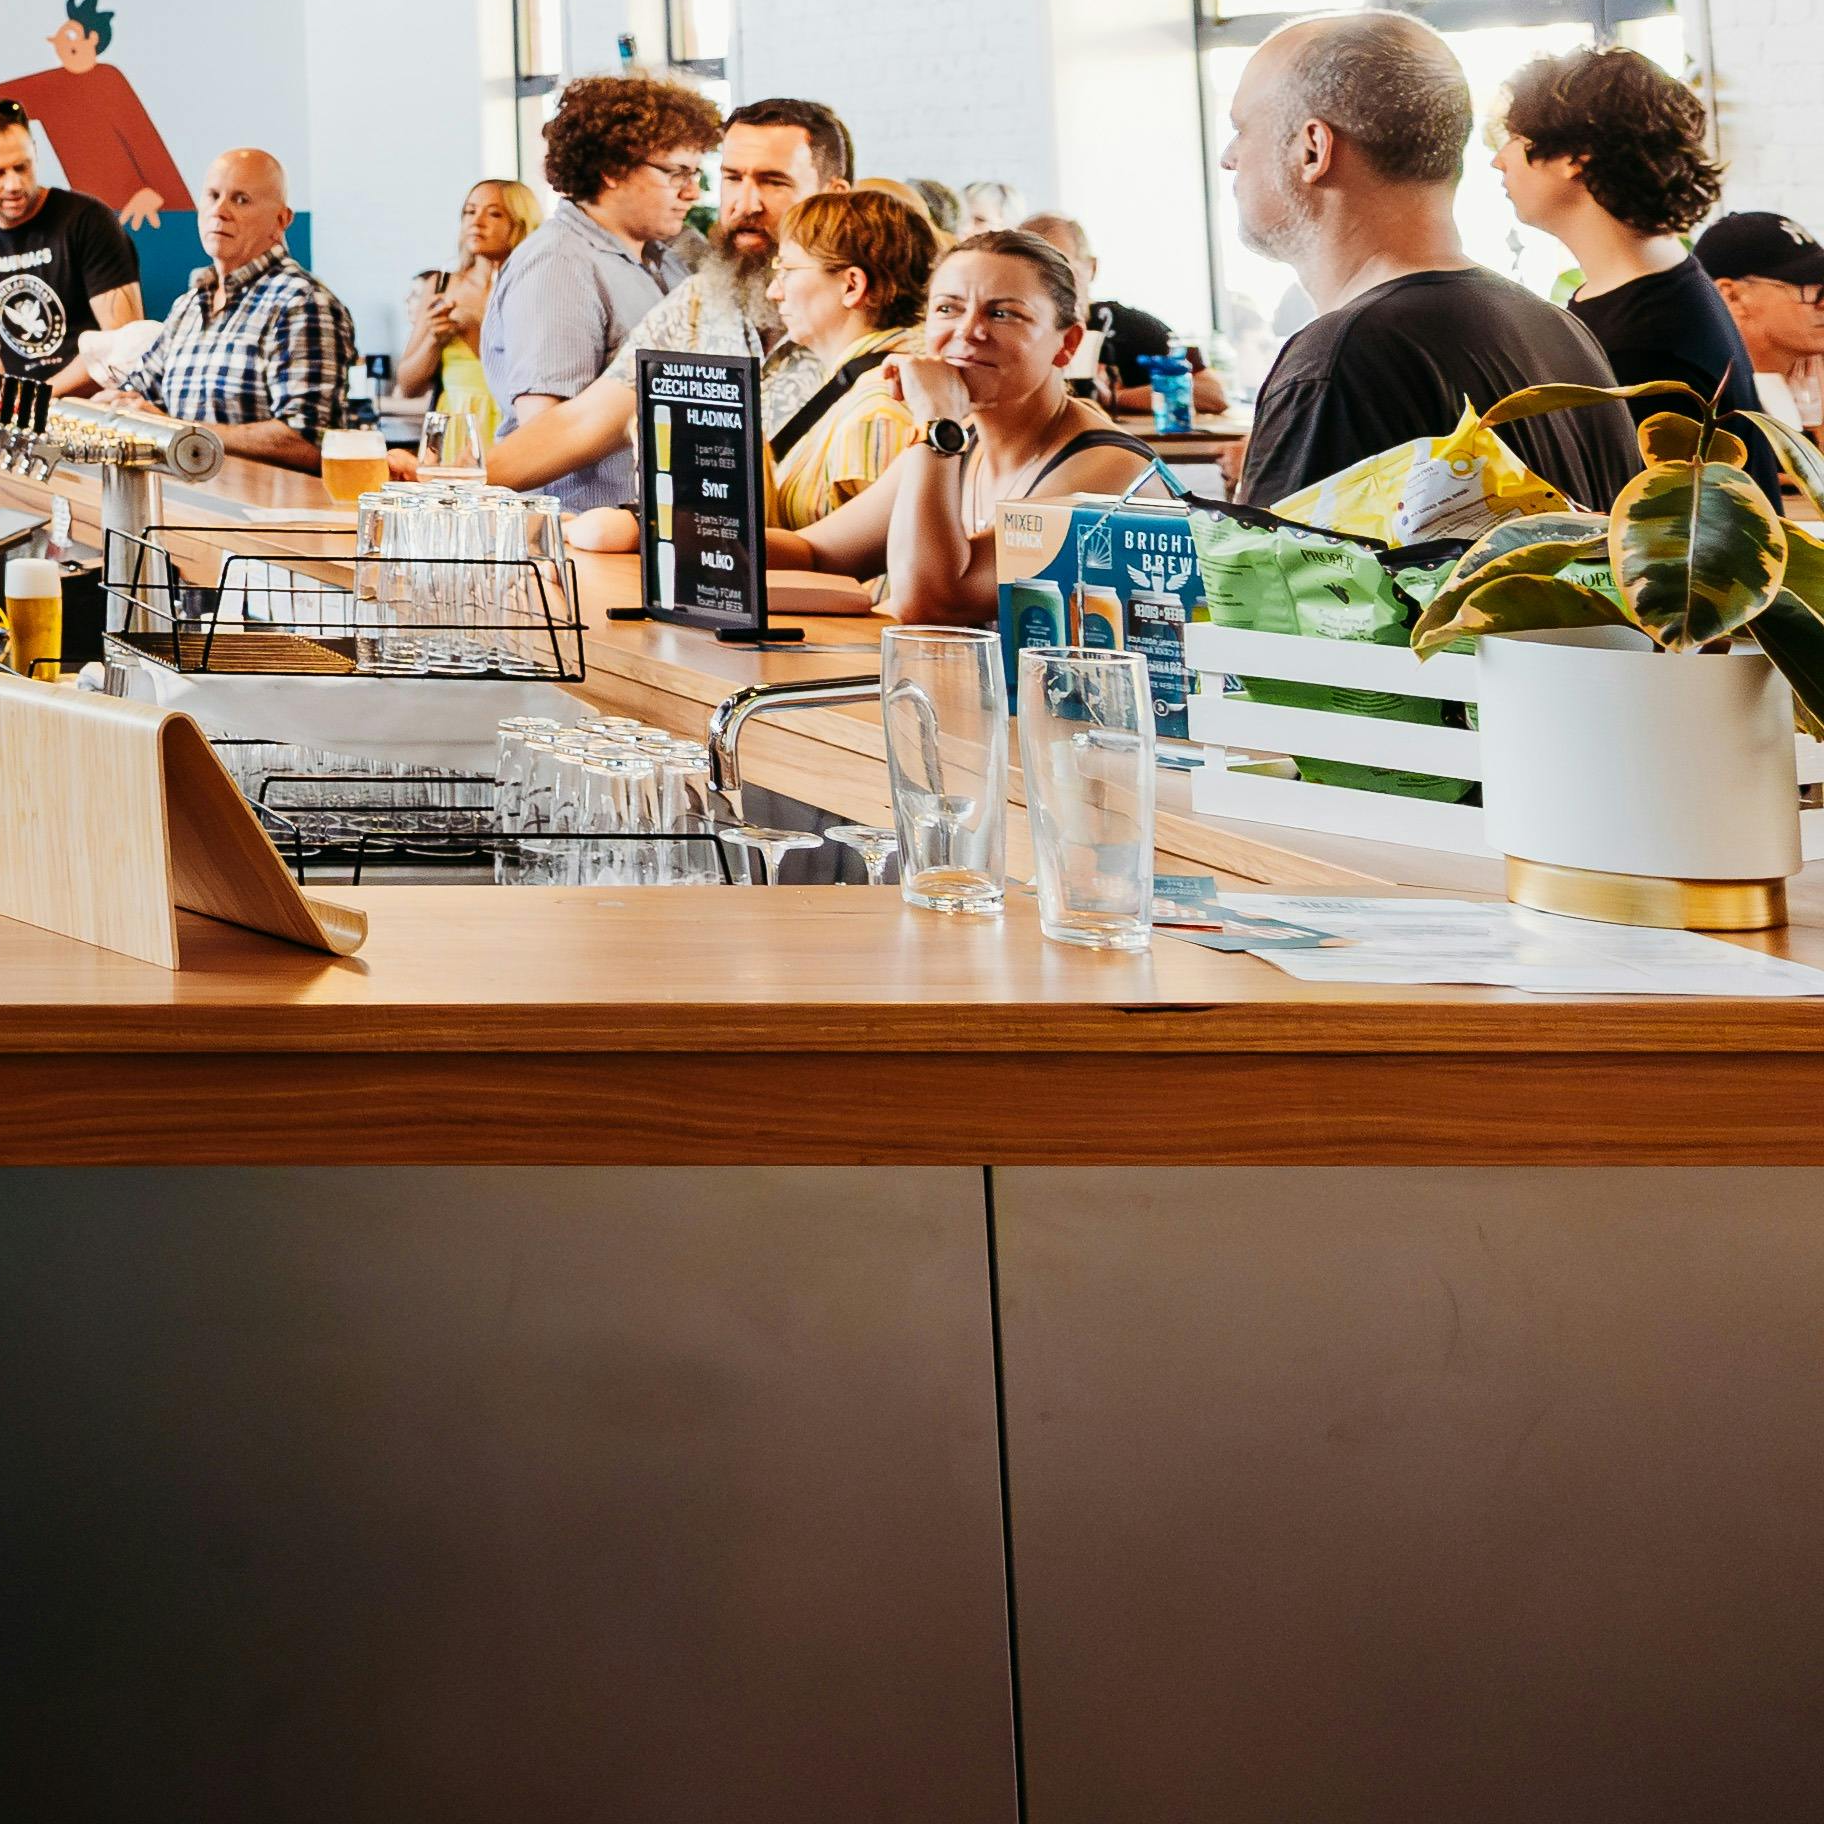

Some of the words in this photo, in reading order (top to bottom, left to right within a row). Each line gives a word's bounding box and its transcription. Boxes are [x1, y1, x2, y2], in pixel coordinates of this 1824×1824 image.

[663, 363, 694, 378] SLOW
[695, 366, 727, 381] POUR
[652, 377, 688, 396] CZECH
[689, 380, 740, 401] PILSENER
[687, 408, 743, 430] HLADINKA
[701, 478, 729, 499] ŠYNT
[1004, 512, 1043, 532] MIXED
[1301, 549, 1355, 575] PROPER
